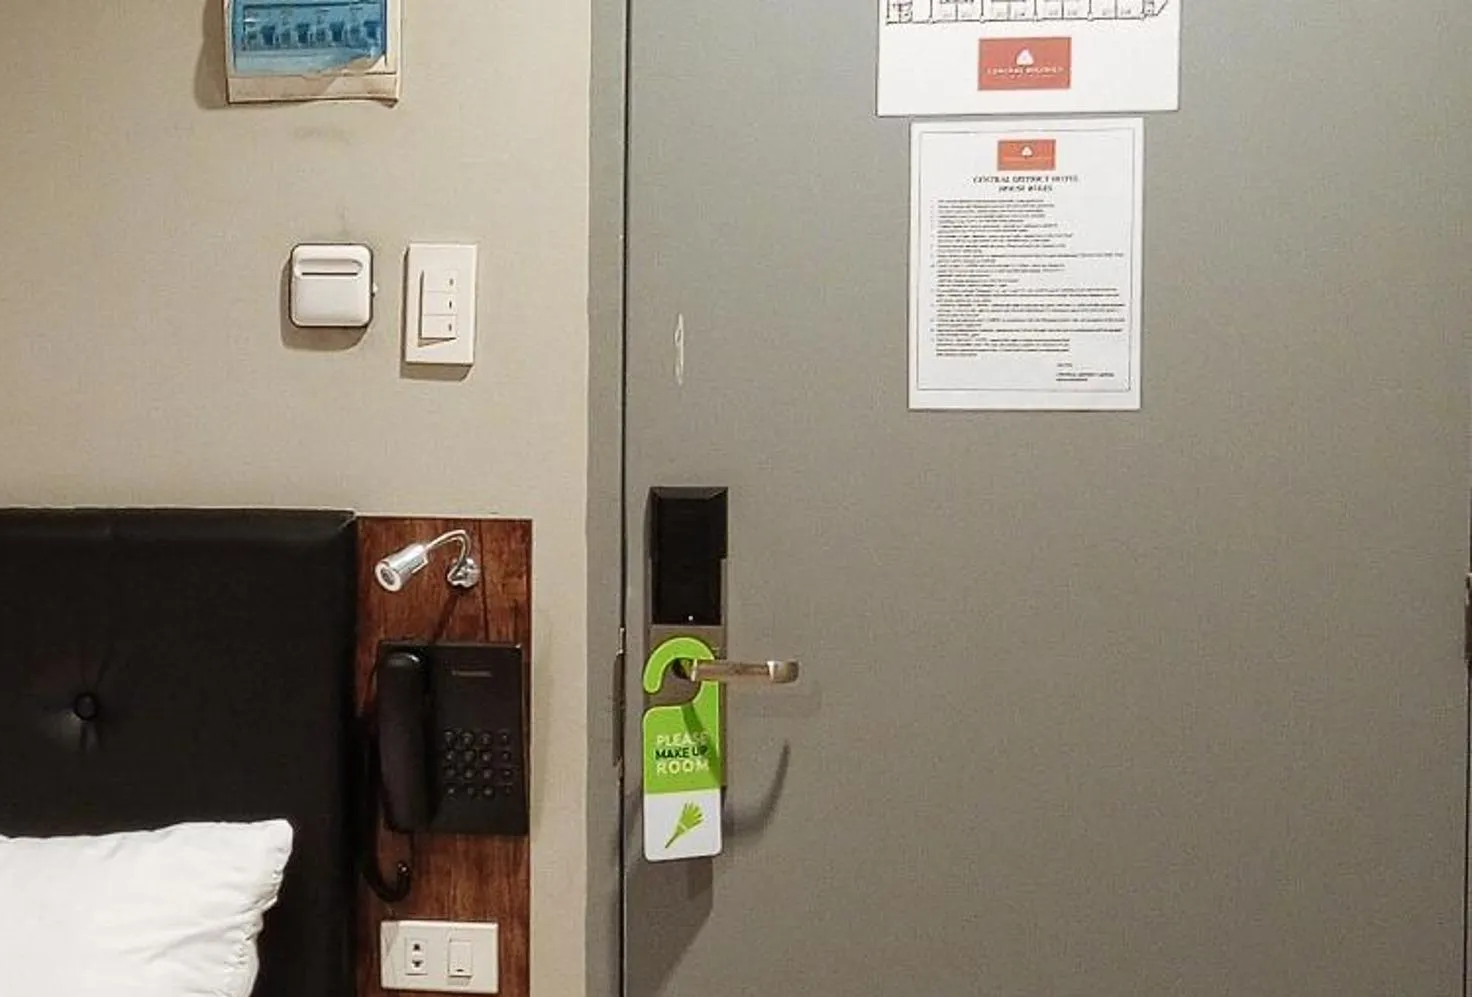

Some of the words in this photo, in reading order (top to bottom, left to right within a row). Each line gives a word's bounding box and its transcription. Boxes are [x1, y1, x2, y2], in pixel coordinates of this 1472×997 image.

[655, 746, 690, 761] MAKE
[692, 744, 708, 757] UP
[656, 758, 710, 777] ROOM
